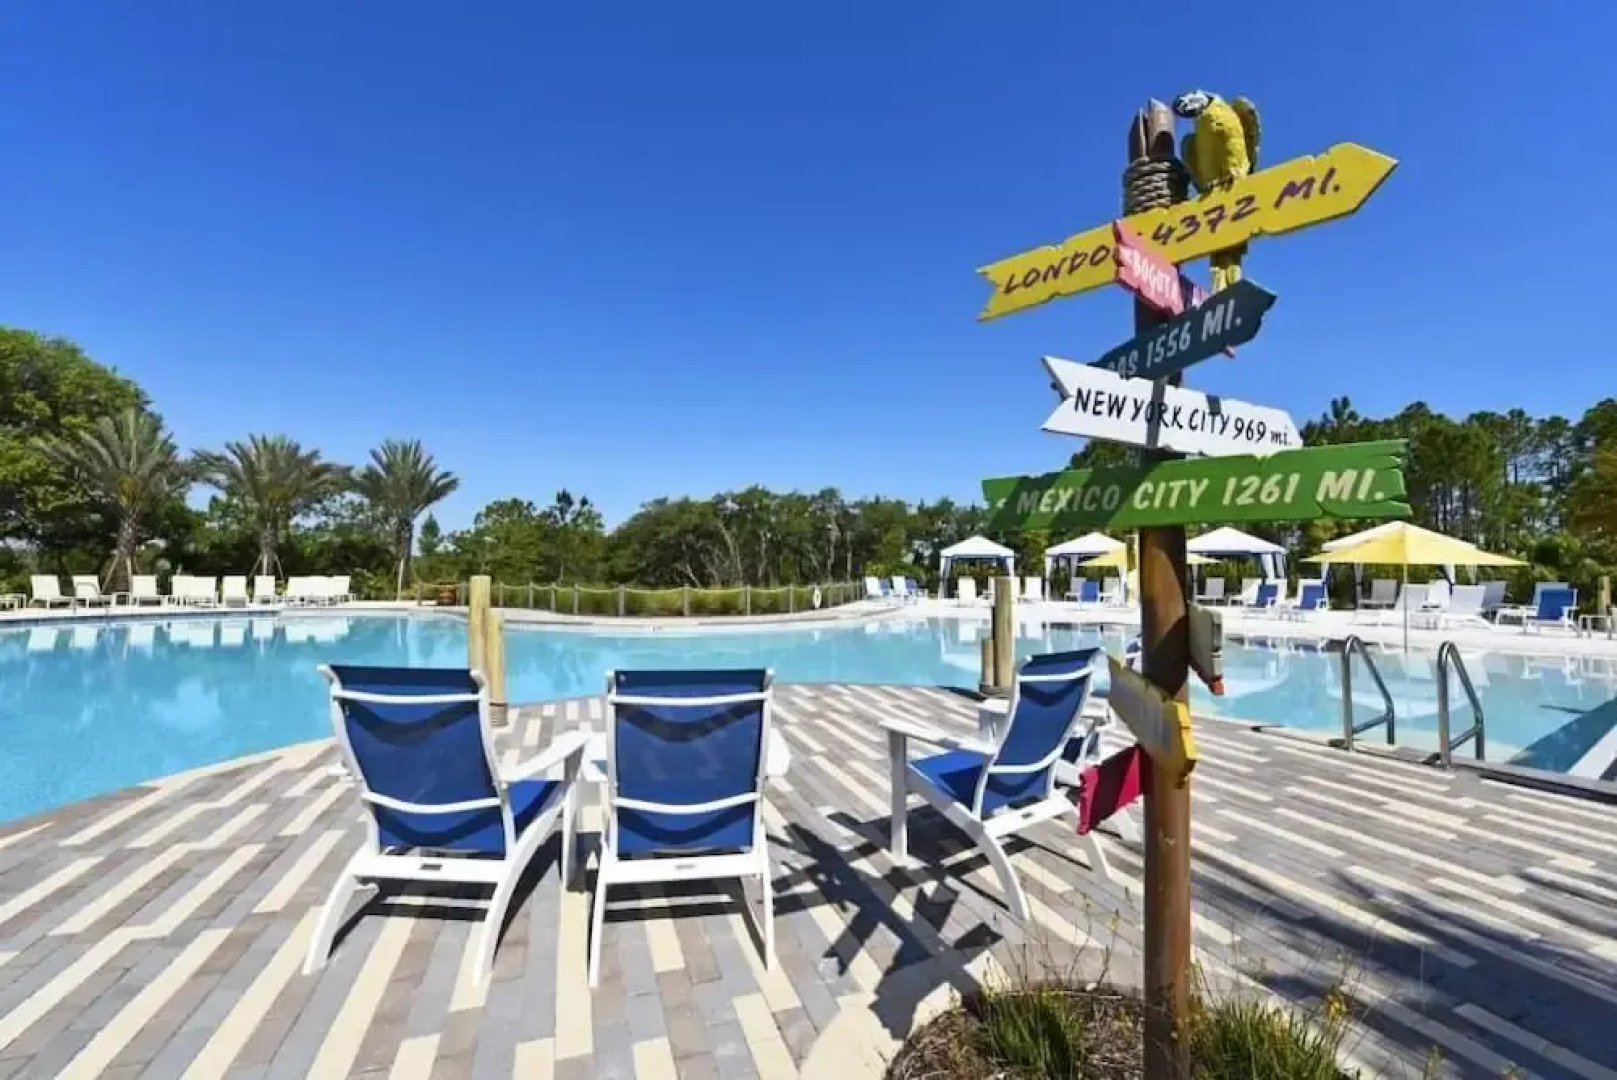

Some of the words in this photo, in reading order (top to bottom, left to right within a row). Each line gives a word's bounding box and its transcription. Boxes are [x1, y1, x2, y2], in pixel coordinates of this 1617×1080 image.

[1003, 245, 1113, 295] LONDO
[1151, 194, 1259, 246] 4372
[1274, 168, 1341, 209] MI.
[1146, 320, 1192, 368] 1556
[1202, 299, 1243, 342] MI.
[1074, 387, 1127, 419] NEW
[1131, 397, 1183, 430] YORK
[1189, 407, 1230, 436] CITY
[1232, 417, 1267, 444] 969
[1270, 426, 1293, 447] mi.
[1016, 484, 1121, 514] MEXICO
[1132, 478, 1211, 510] CITY
[1221, 472, 1301, 506] 1261
[1316, 467, 1386, 503] MI.
